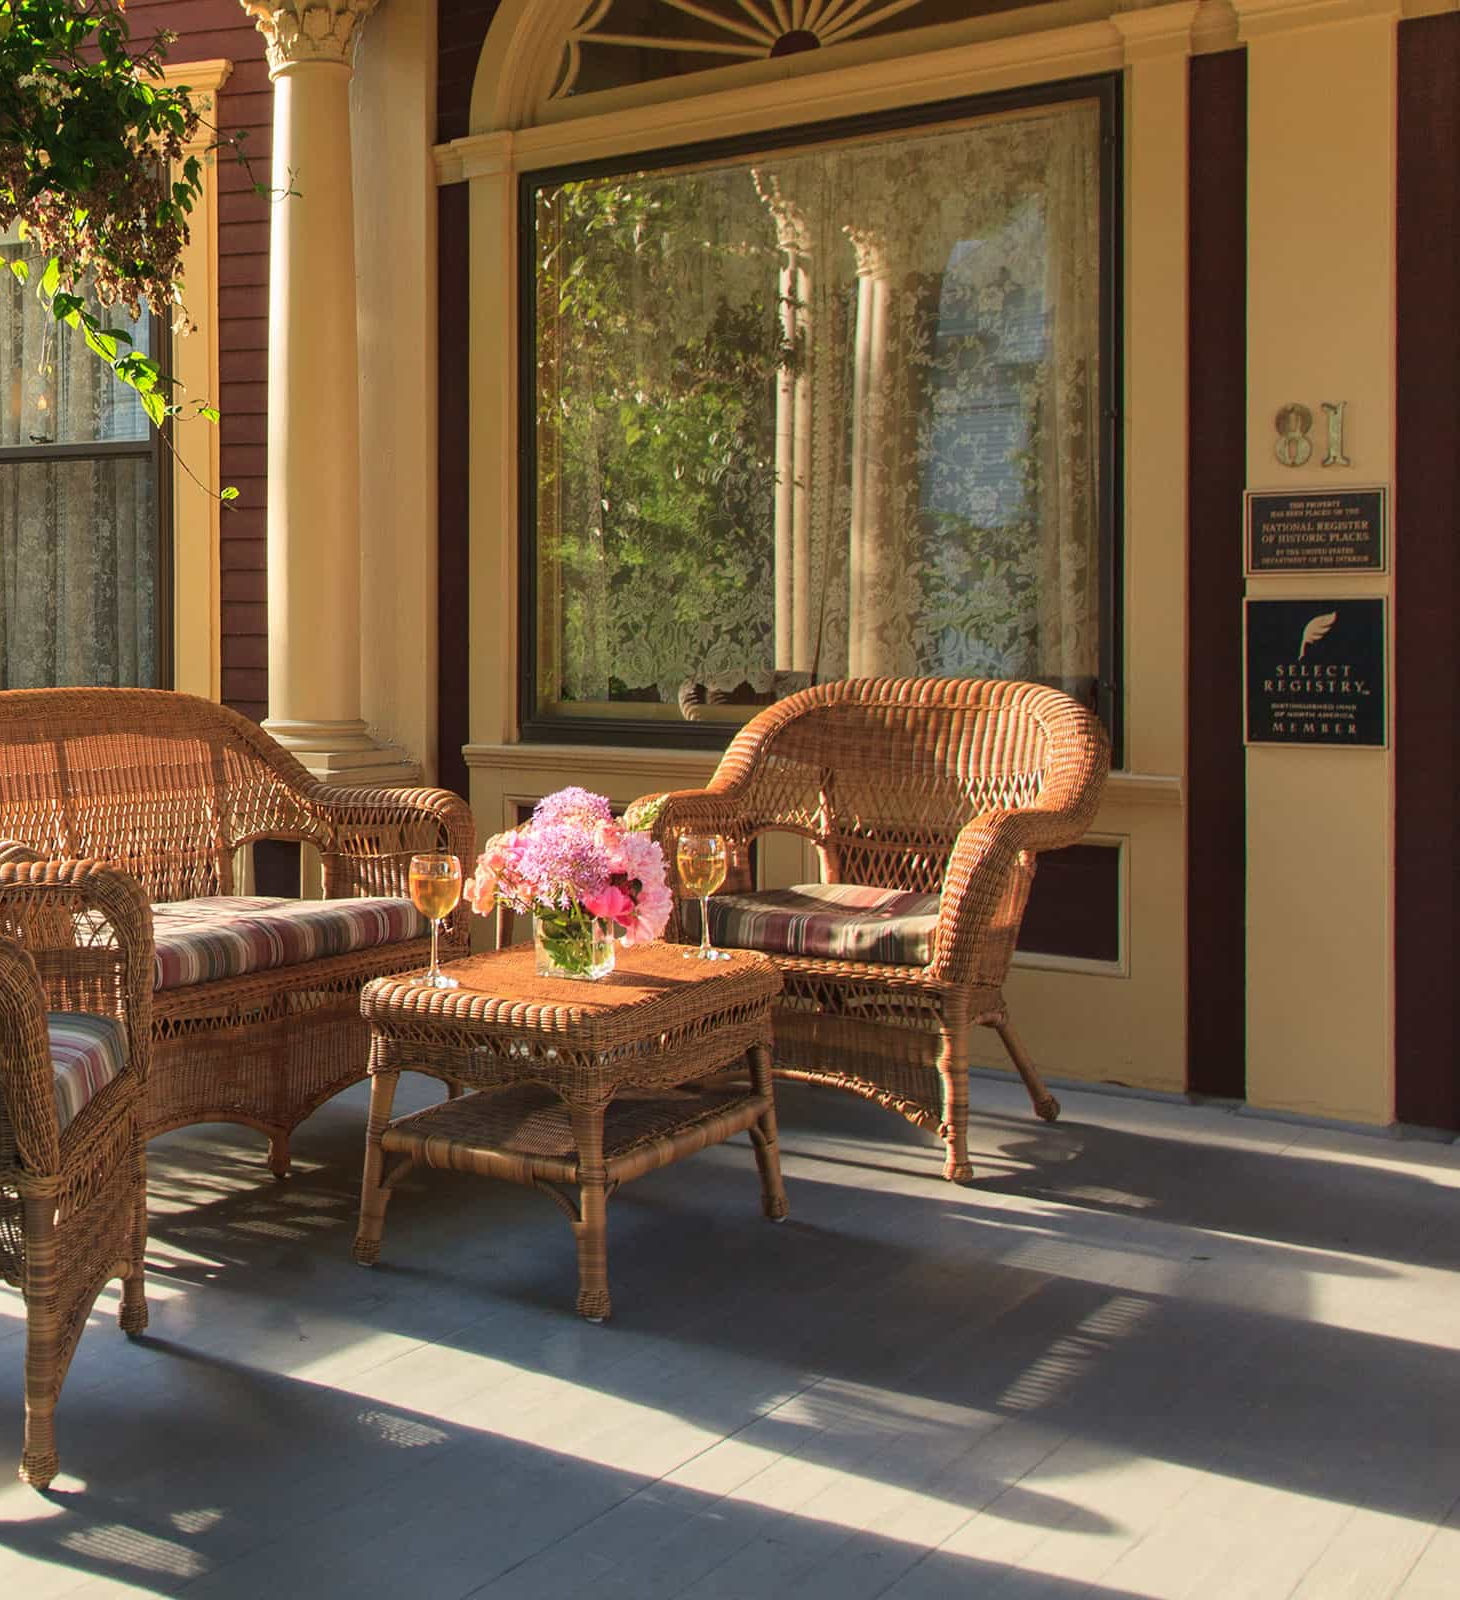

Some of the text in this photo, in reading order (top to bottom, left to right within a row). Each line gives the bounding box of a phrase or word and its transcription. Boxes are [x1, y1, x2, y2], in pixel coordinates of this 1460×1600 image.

[1274, 402, 1349, 467] 81
[1262, 520, 1369, 532] NATIONAL REGISTER
[1261, 532, 1370, 543] OF HISTORIC PLACES
[1276, 664, 1351, 677] SELECT
[1264, 680, 1365, 693] REGISTRY
[1272, 722, 1356, 734] MEMBER
